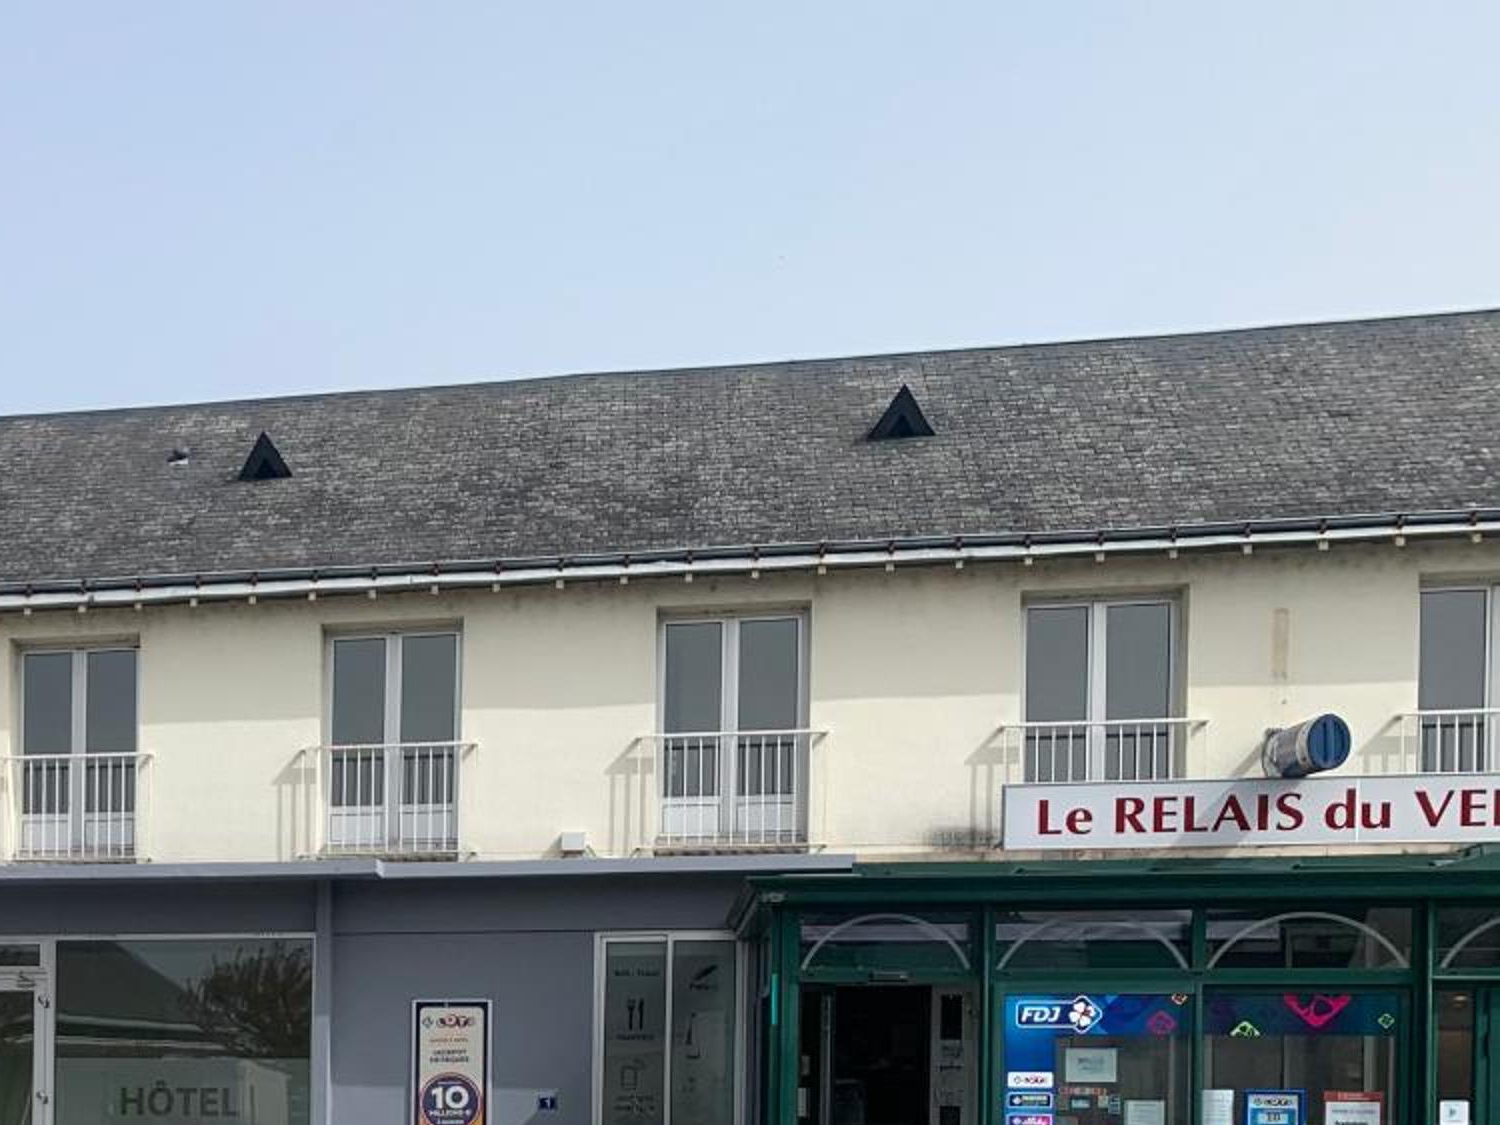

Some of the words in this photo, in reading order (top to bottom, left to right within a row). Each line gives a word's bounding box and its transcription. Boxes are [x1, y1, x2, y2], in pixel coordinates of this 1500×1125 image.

[1037, 799, 1093, 835] Le
[1114, 793, 1304, 834] RELAIS
[1324, 788, 1392, 829] du
[1020, 1006, 1062, 1022] FDJ
[119, 1079, 240, 1117] HÔTEL
[431, 1085, 470, 1109] 10
